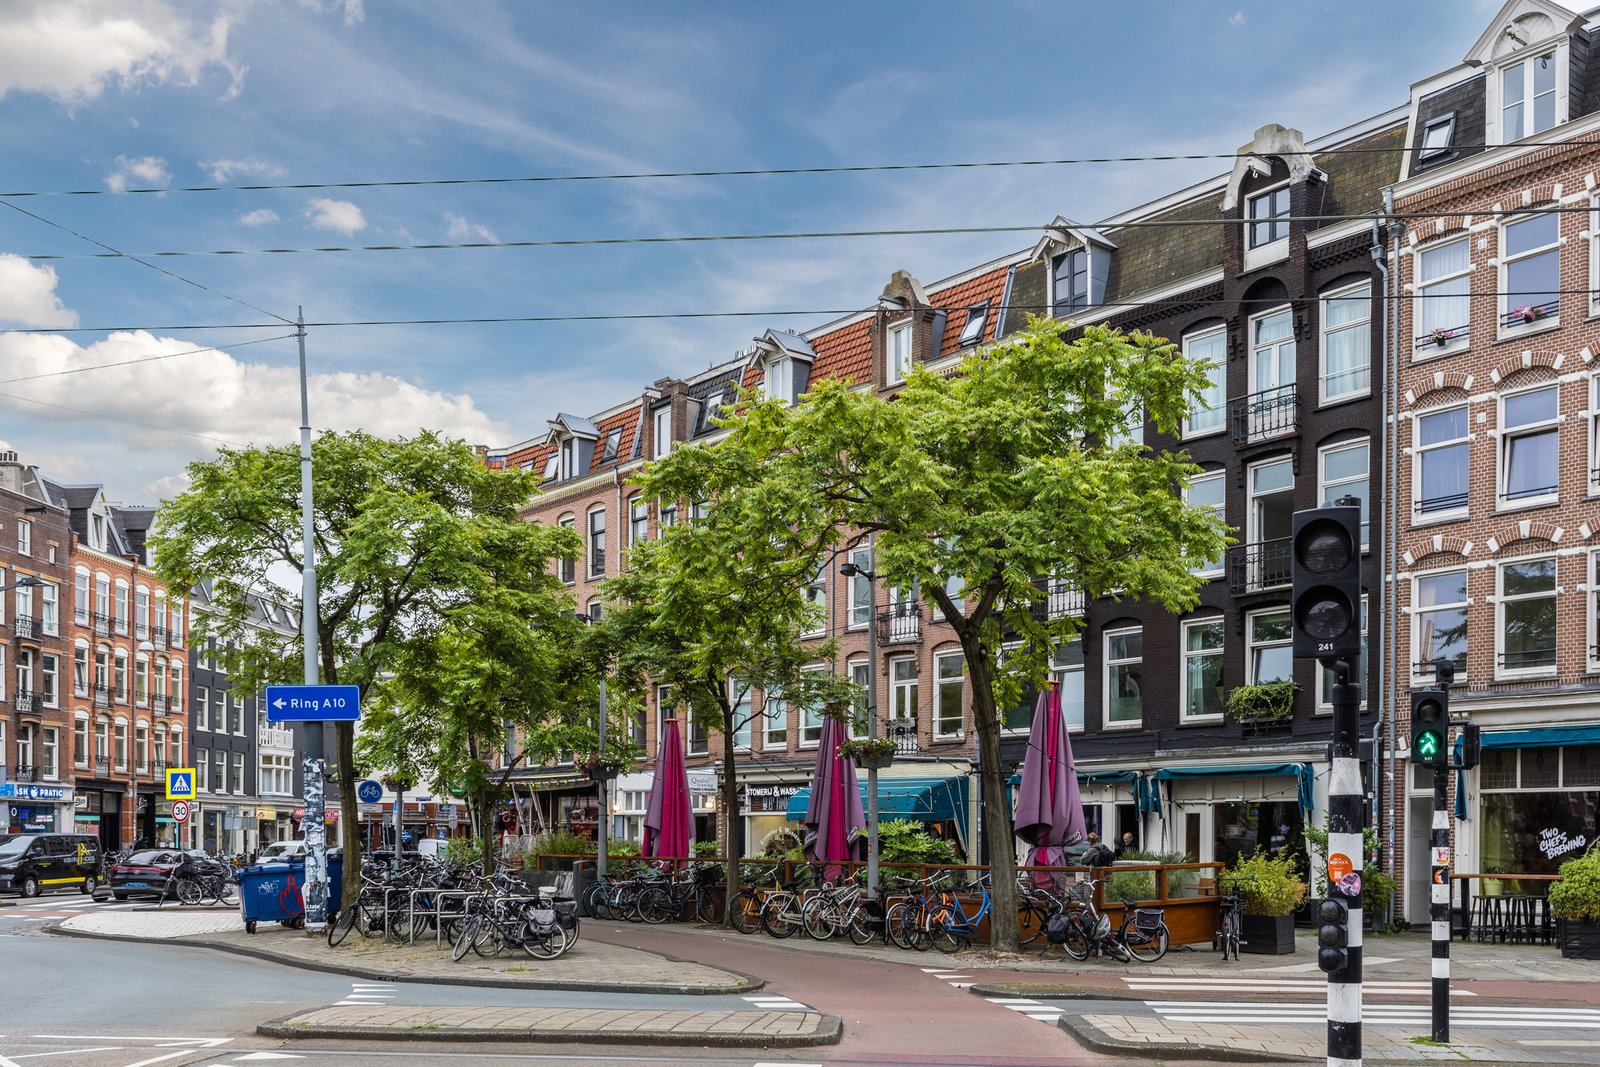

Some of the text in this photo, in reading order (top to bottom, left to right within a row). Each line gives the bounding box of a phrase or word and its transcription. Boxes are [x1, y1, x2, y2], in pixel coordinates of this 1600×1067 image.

[1318, 643, 1333, 651] 241
[291, 698, 346, 711] Ring A10
[40, 788, 63, 797] PRATIC
[746, 787, 773, 796] STOMERIJ
[773, 785, 780, 797] &
[174, 806, 186, 816] 30
[1540, 827, 1559, 840] TWO
[1540, 831, 1568, 852] CHEFS
[1545, 834, 1586, 860] BREWING
